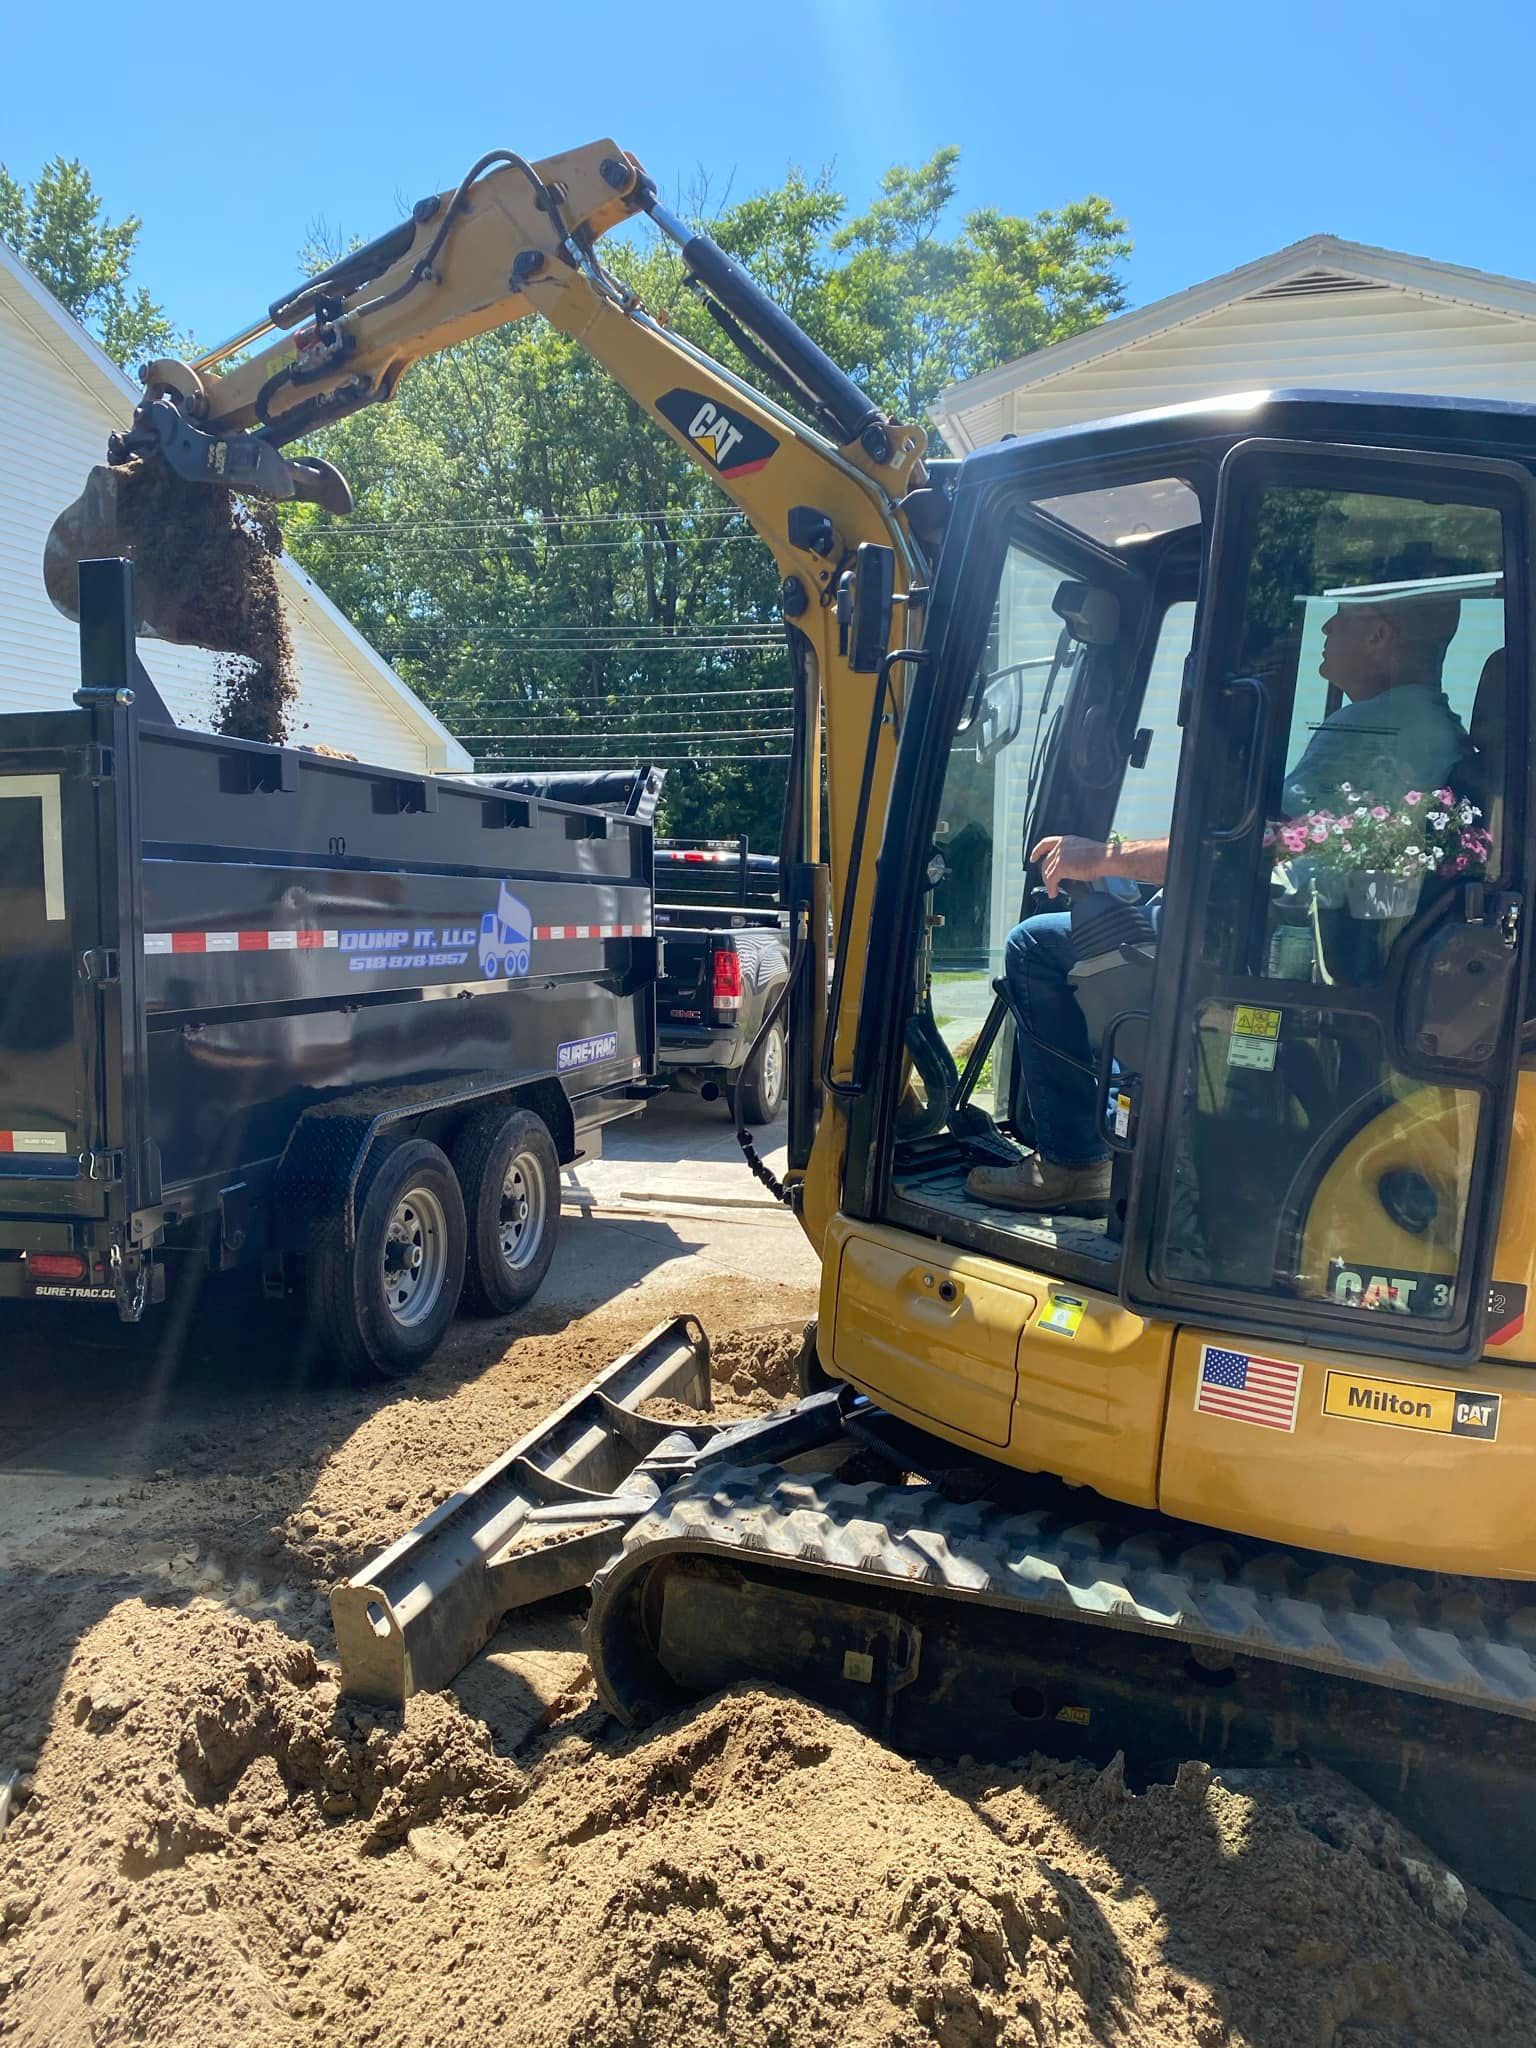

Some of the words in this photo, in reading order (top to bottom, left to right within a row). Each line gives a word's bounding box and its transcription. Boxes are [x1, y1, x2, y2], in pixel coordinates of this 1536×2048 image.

[688, 402, 744, 464] CAT
[340, 930, 409, 951] DUMP
[441, 929, 477, 946] LLC
[559, 1036, 616, 1068] SURE-TRAC
[35, 1286, 117, 1298] SURE-TRAC.CO
[1335, 1271, 1418, 1313] CAT
[1348, 1386, 1432, 1418] Milton
[1456, 1403, 1492, 1427] CAT
